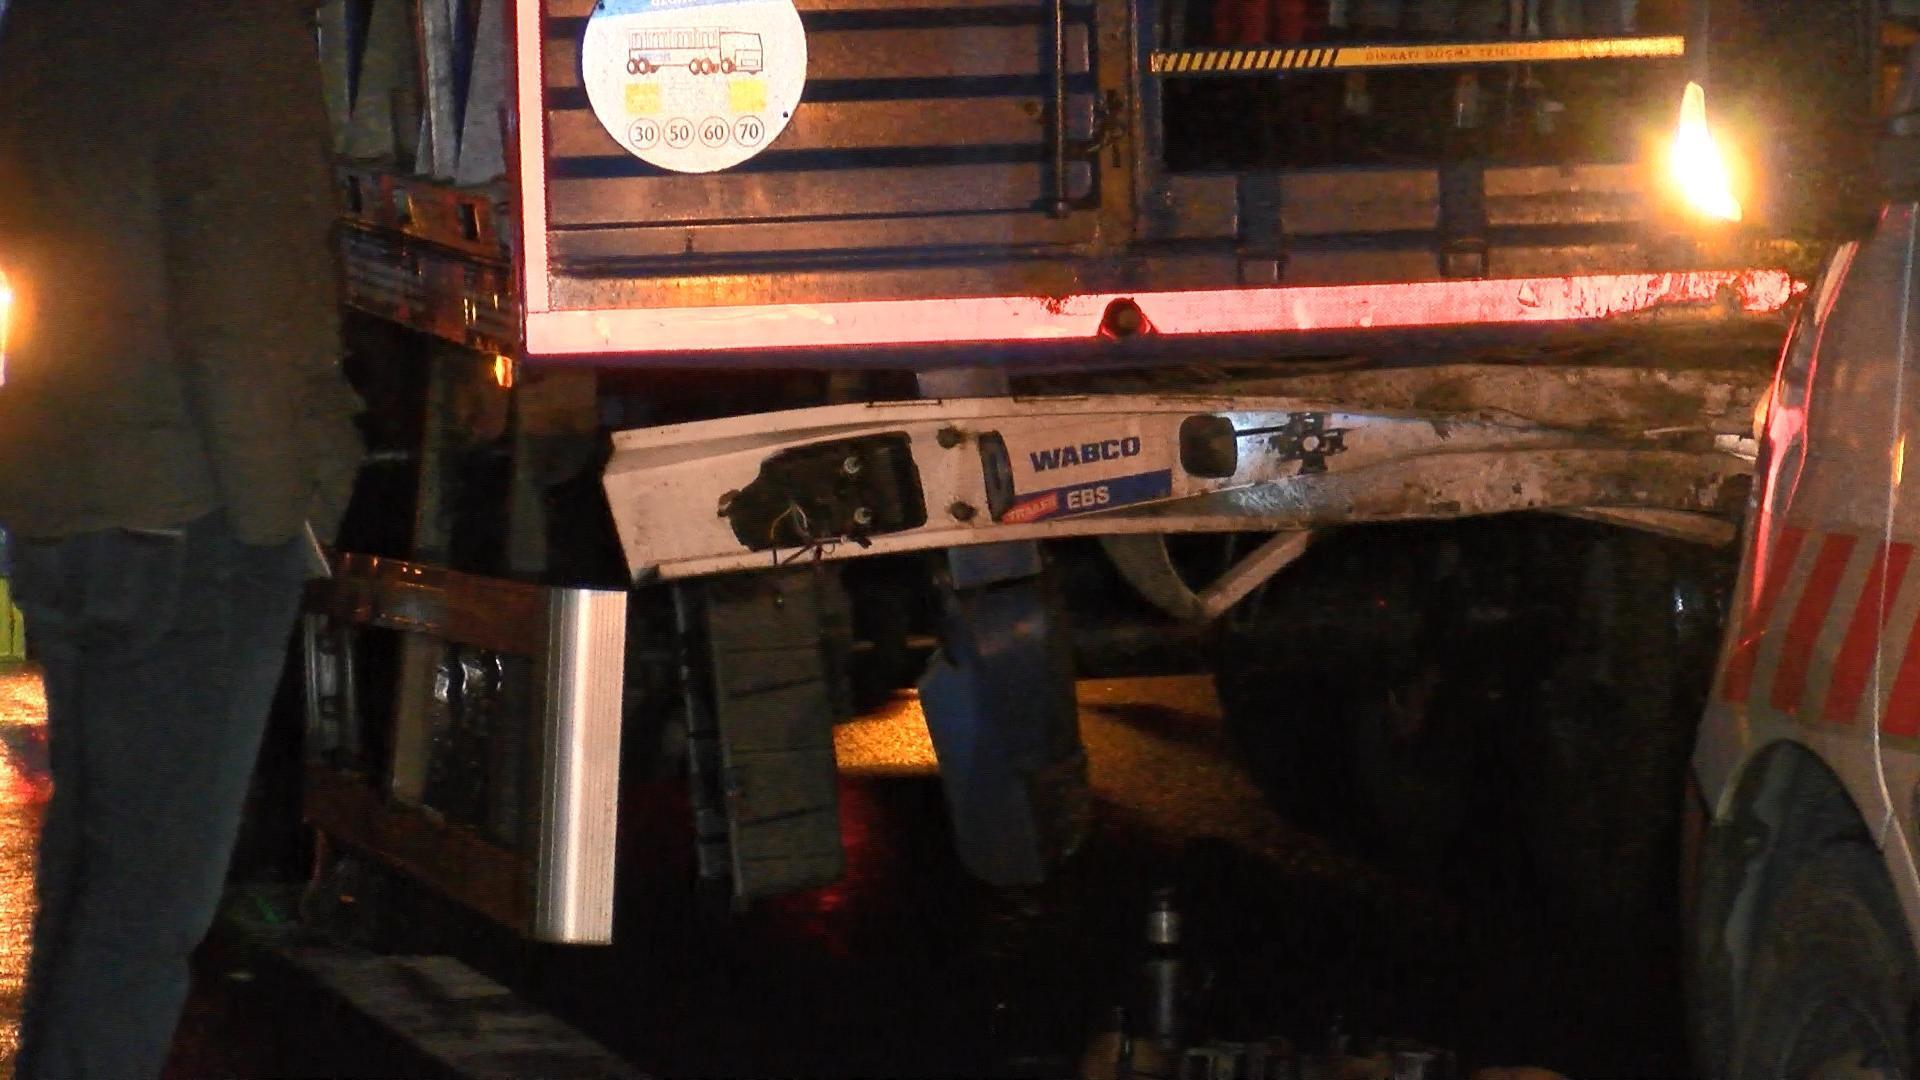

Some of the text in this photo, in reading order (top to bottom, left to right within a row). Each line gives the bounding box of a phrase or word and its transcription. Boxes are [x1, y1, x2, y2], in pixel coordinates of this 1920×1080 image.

[634, 123, 759, 142] 30 50 60 70
[1030, 436, 1141, 473] WABCO
[1067, 486, 1111, 510] EBS
